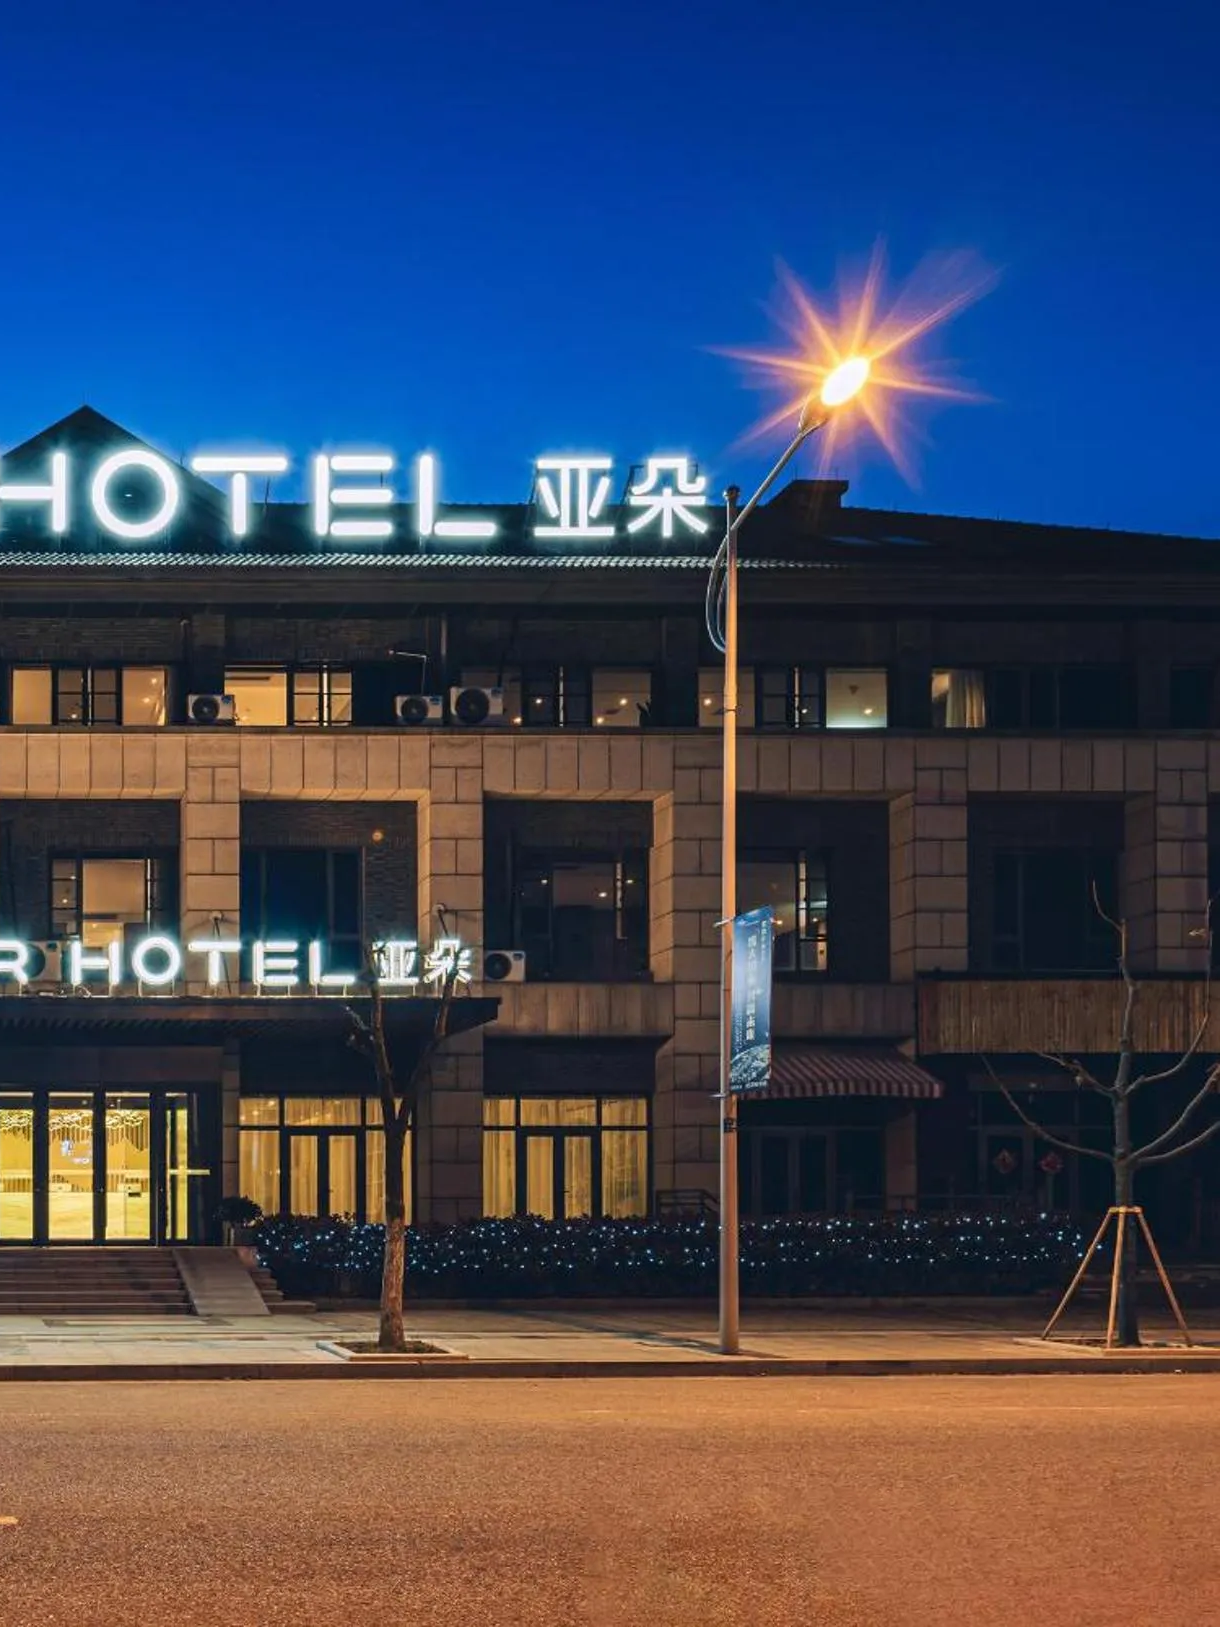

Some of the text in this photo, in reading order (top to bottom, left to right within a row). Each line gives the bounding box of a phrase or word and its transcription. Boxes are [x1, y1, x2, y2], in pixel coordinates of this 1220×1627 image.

[534, 457, 708, 538] 亚朵
[70, 936, 356, 985] HOTEL
[371, 939, 473, 984] 亚朵
